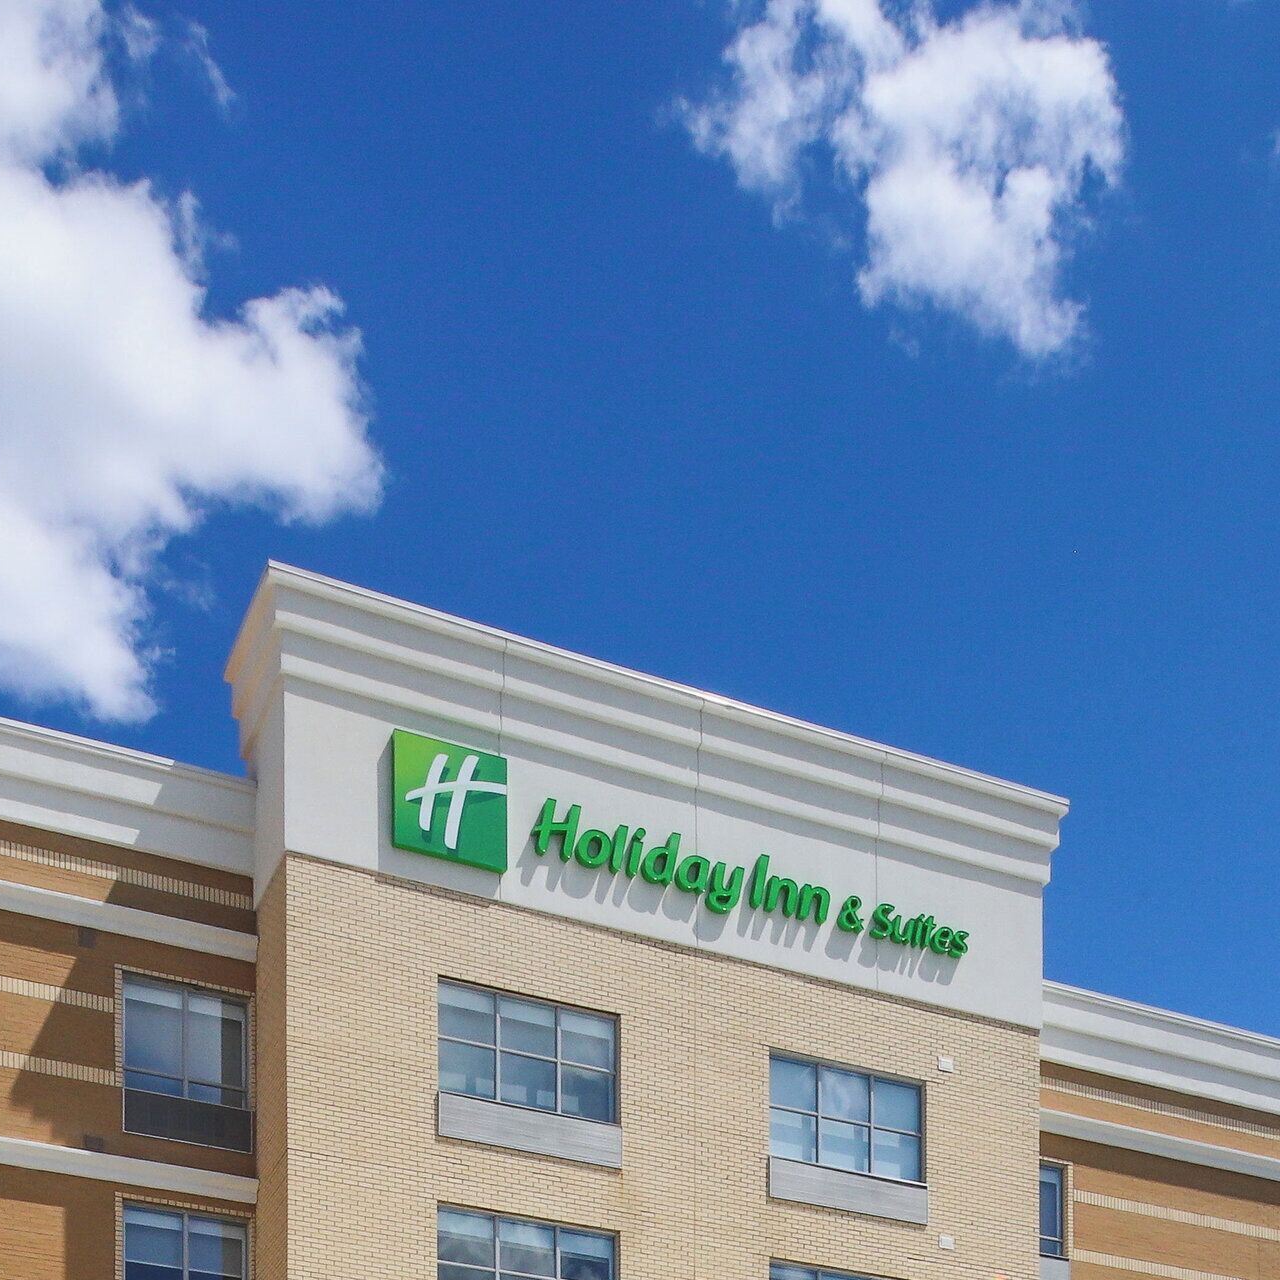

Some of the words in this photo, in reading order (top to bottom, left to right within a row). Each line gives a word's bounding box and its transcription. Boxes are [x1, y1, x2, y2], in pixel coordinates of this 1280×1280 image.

[531, 797, 745, 914] Holiday
[749, 854, 831, 926] Inn
[836, 895, 865, 935] &
[869, 903, 970, 959] Suites
